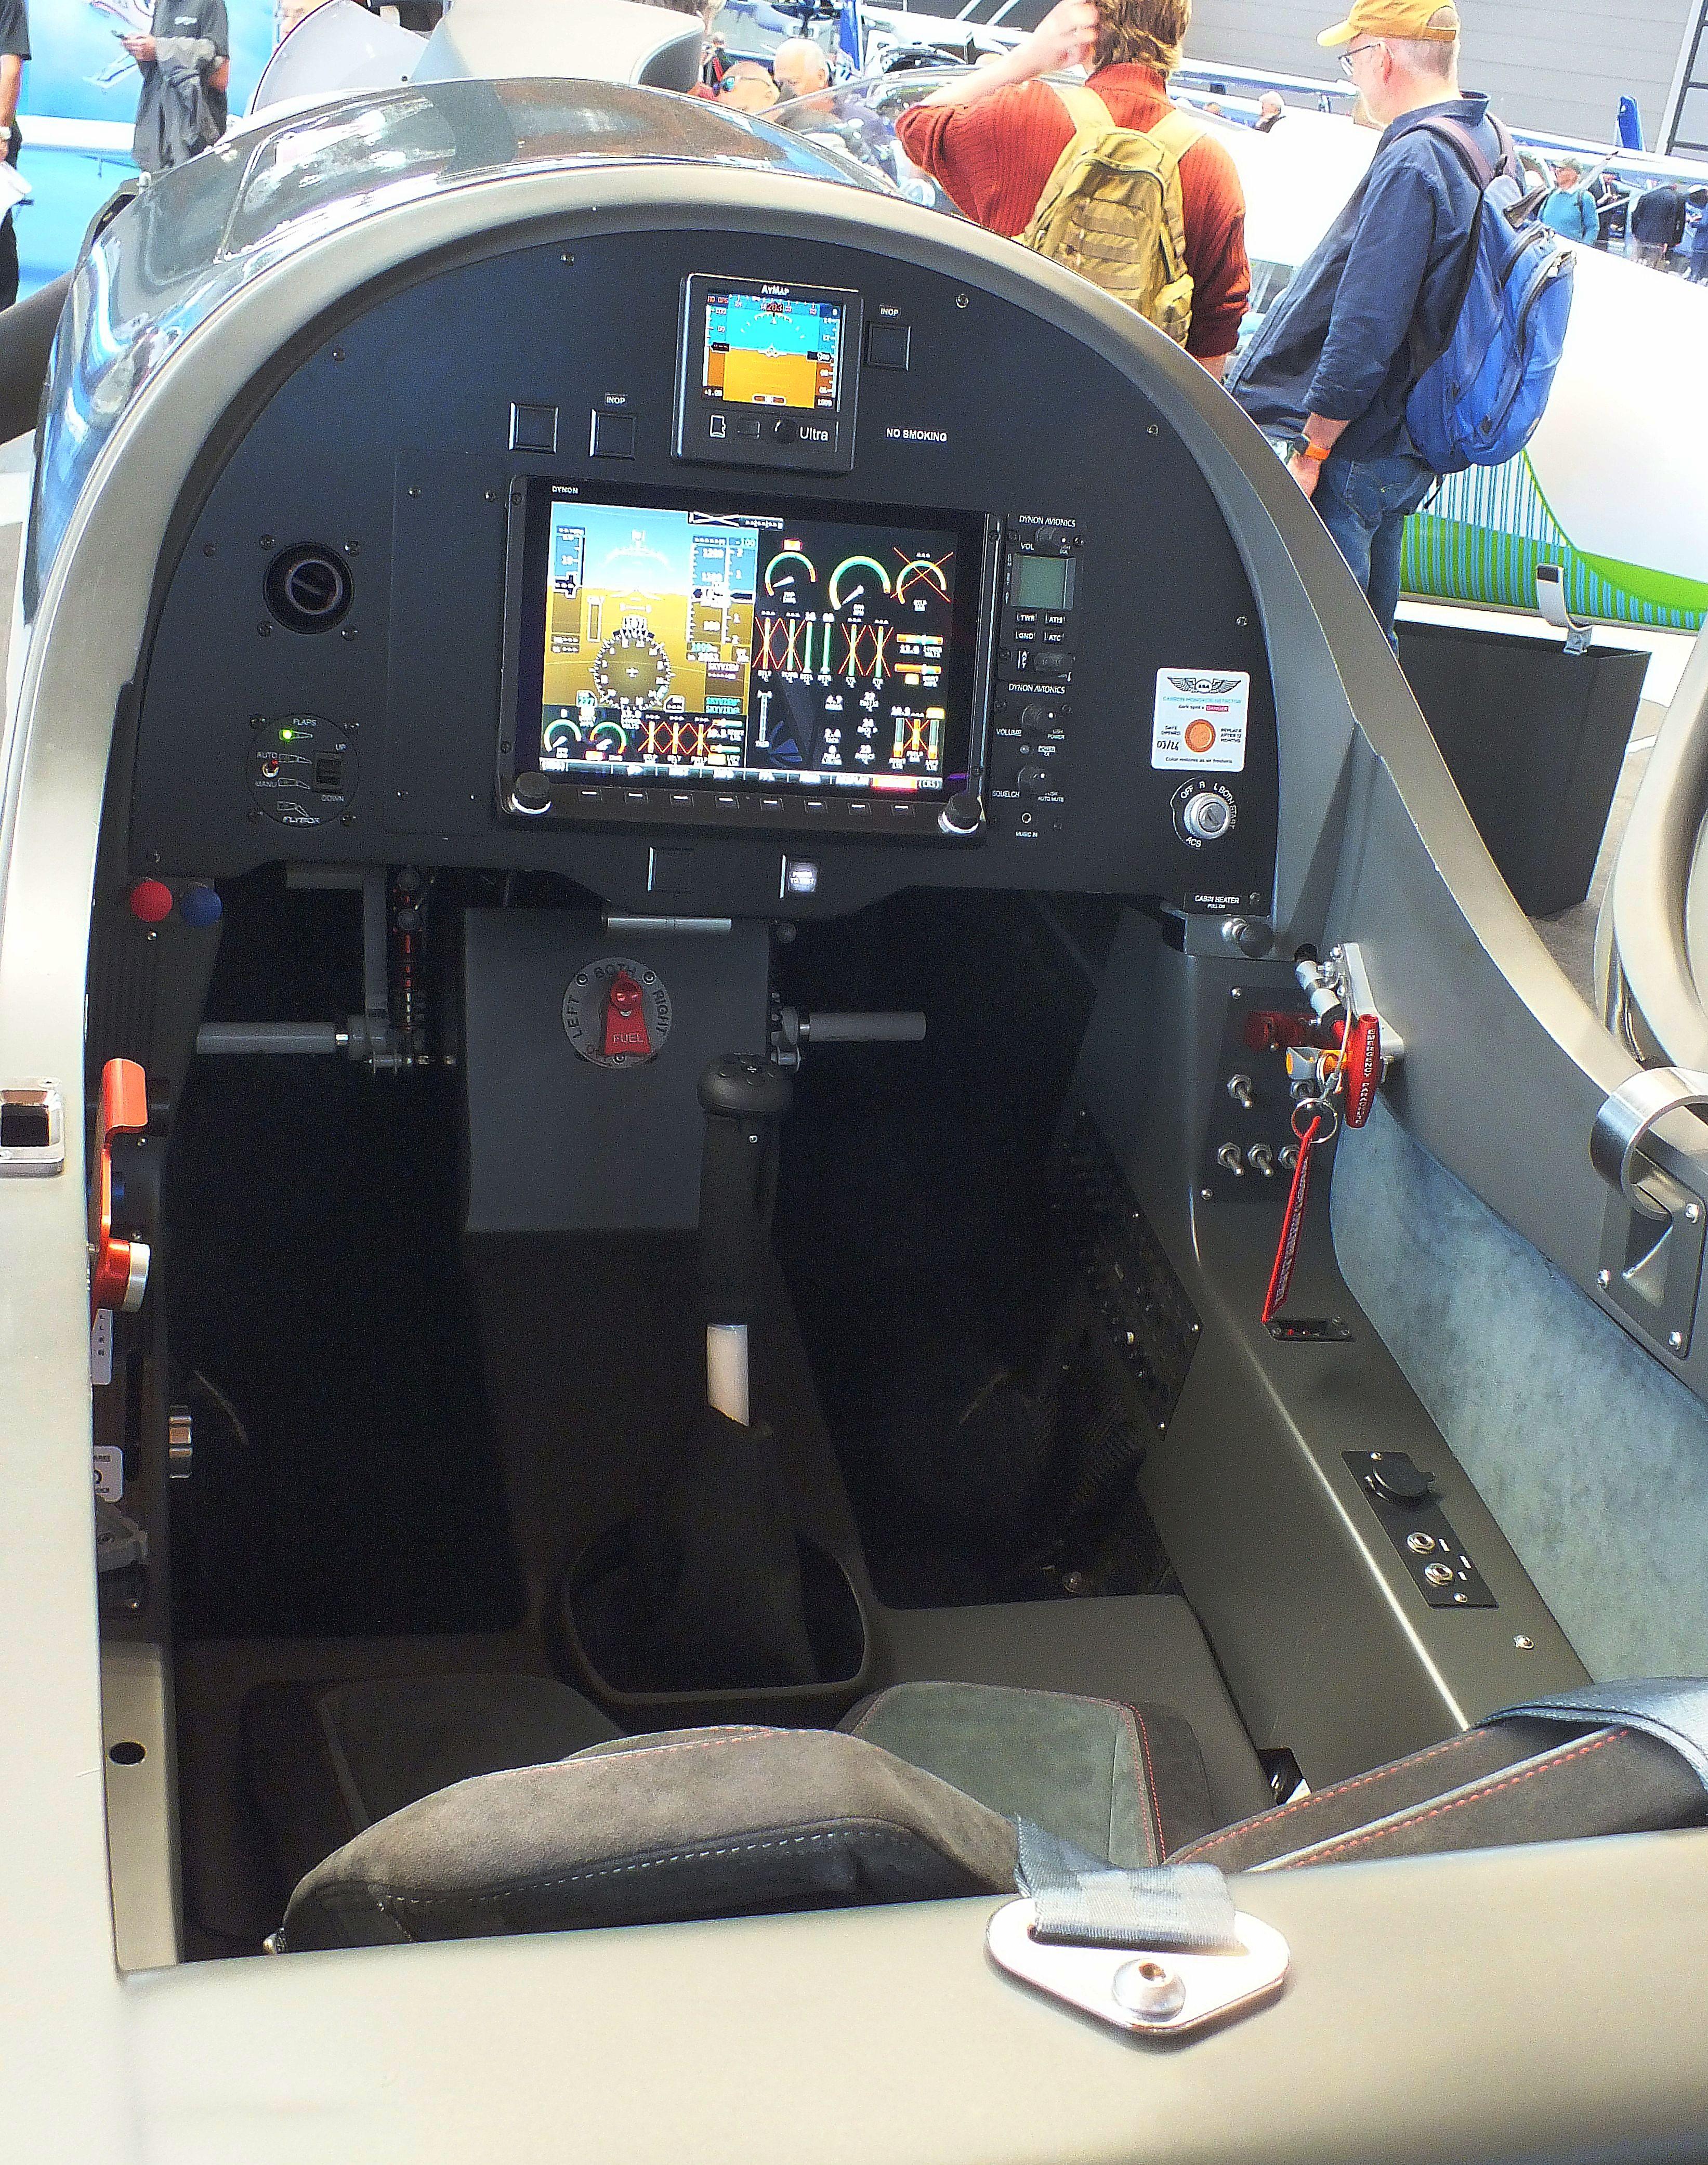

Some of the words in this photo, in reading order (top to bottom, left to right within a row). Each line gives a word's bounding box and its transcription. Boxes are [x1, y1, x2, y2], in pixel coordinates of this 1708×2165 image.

[606, 396, 625, 404] INOP
[800, 426, 828, 441] Ultra
[886, 428, 900, 438] NO
[903, 429, 947, 442] SMOKING
[552, 486, 579, 494] DYNON
[1019, 515, 1044, 524] DYNON
[1045, 517, 1075, 527] AVIONICS
[1009, 684, 1032, 692] DYNON
[1034, 685, 1065, 693] AVIONICS
[1180, 785, 1194, 799] OFF
[1218, 785, 1234, 804] BOTH
[1186, 836, 1202, 847] ACS
[566, 994, 583, 1039] LEFT
[653, 990, 670, 1036] RIGHT
[613, 1033, 644, 1043] FUEL
[1363, 1029, 1375, 1078] EMERGENCY
